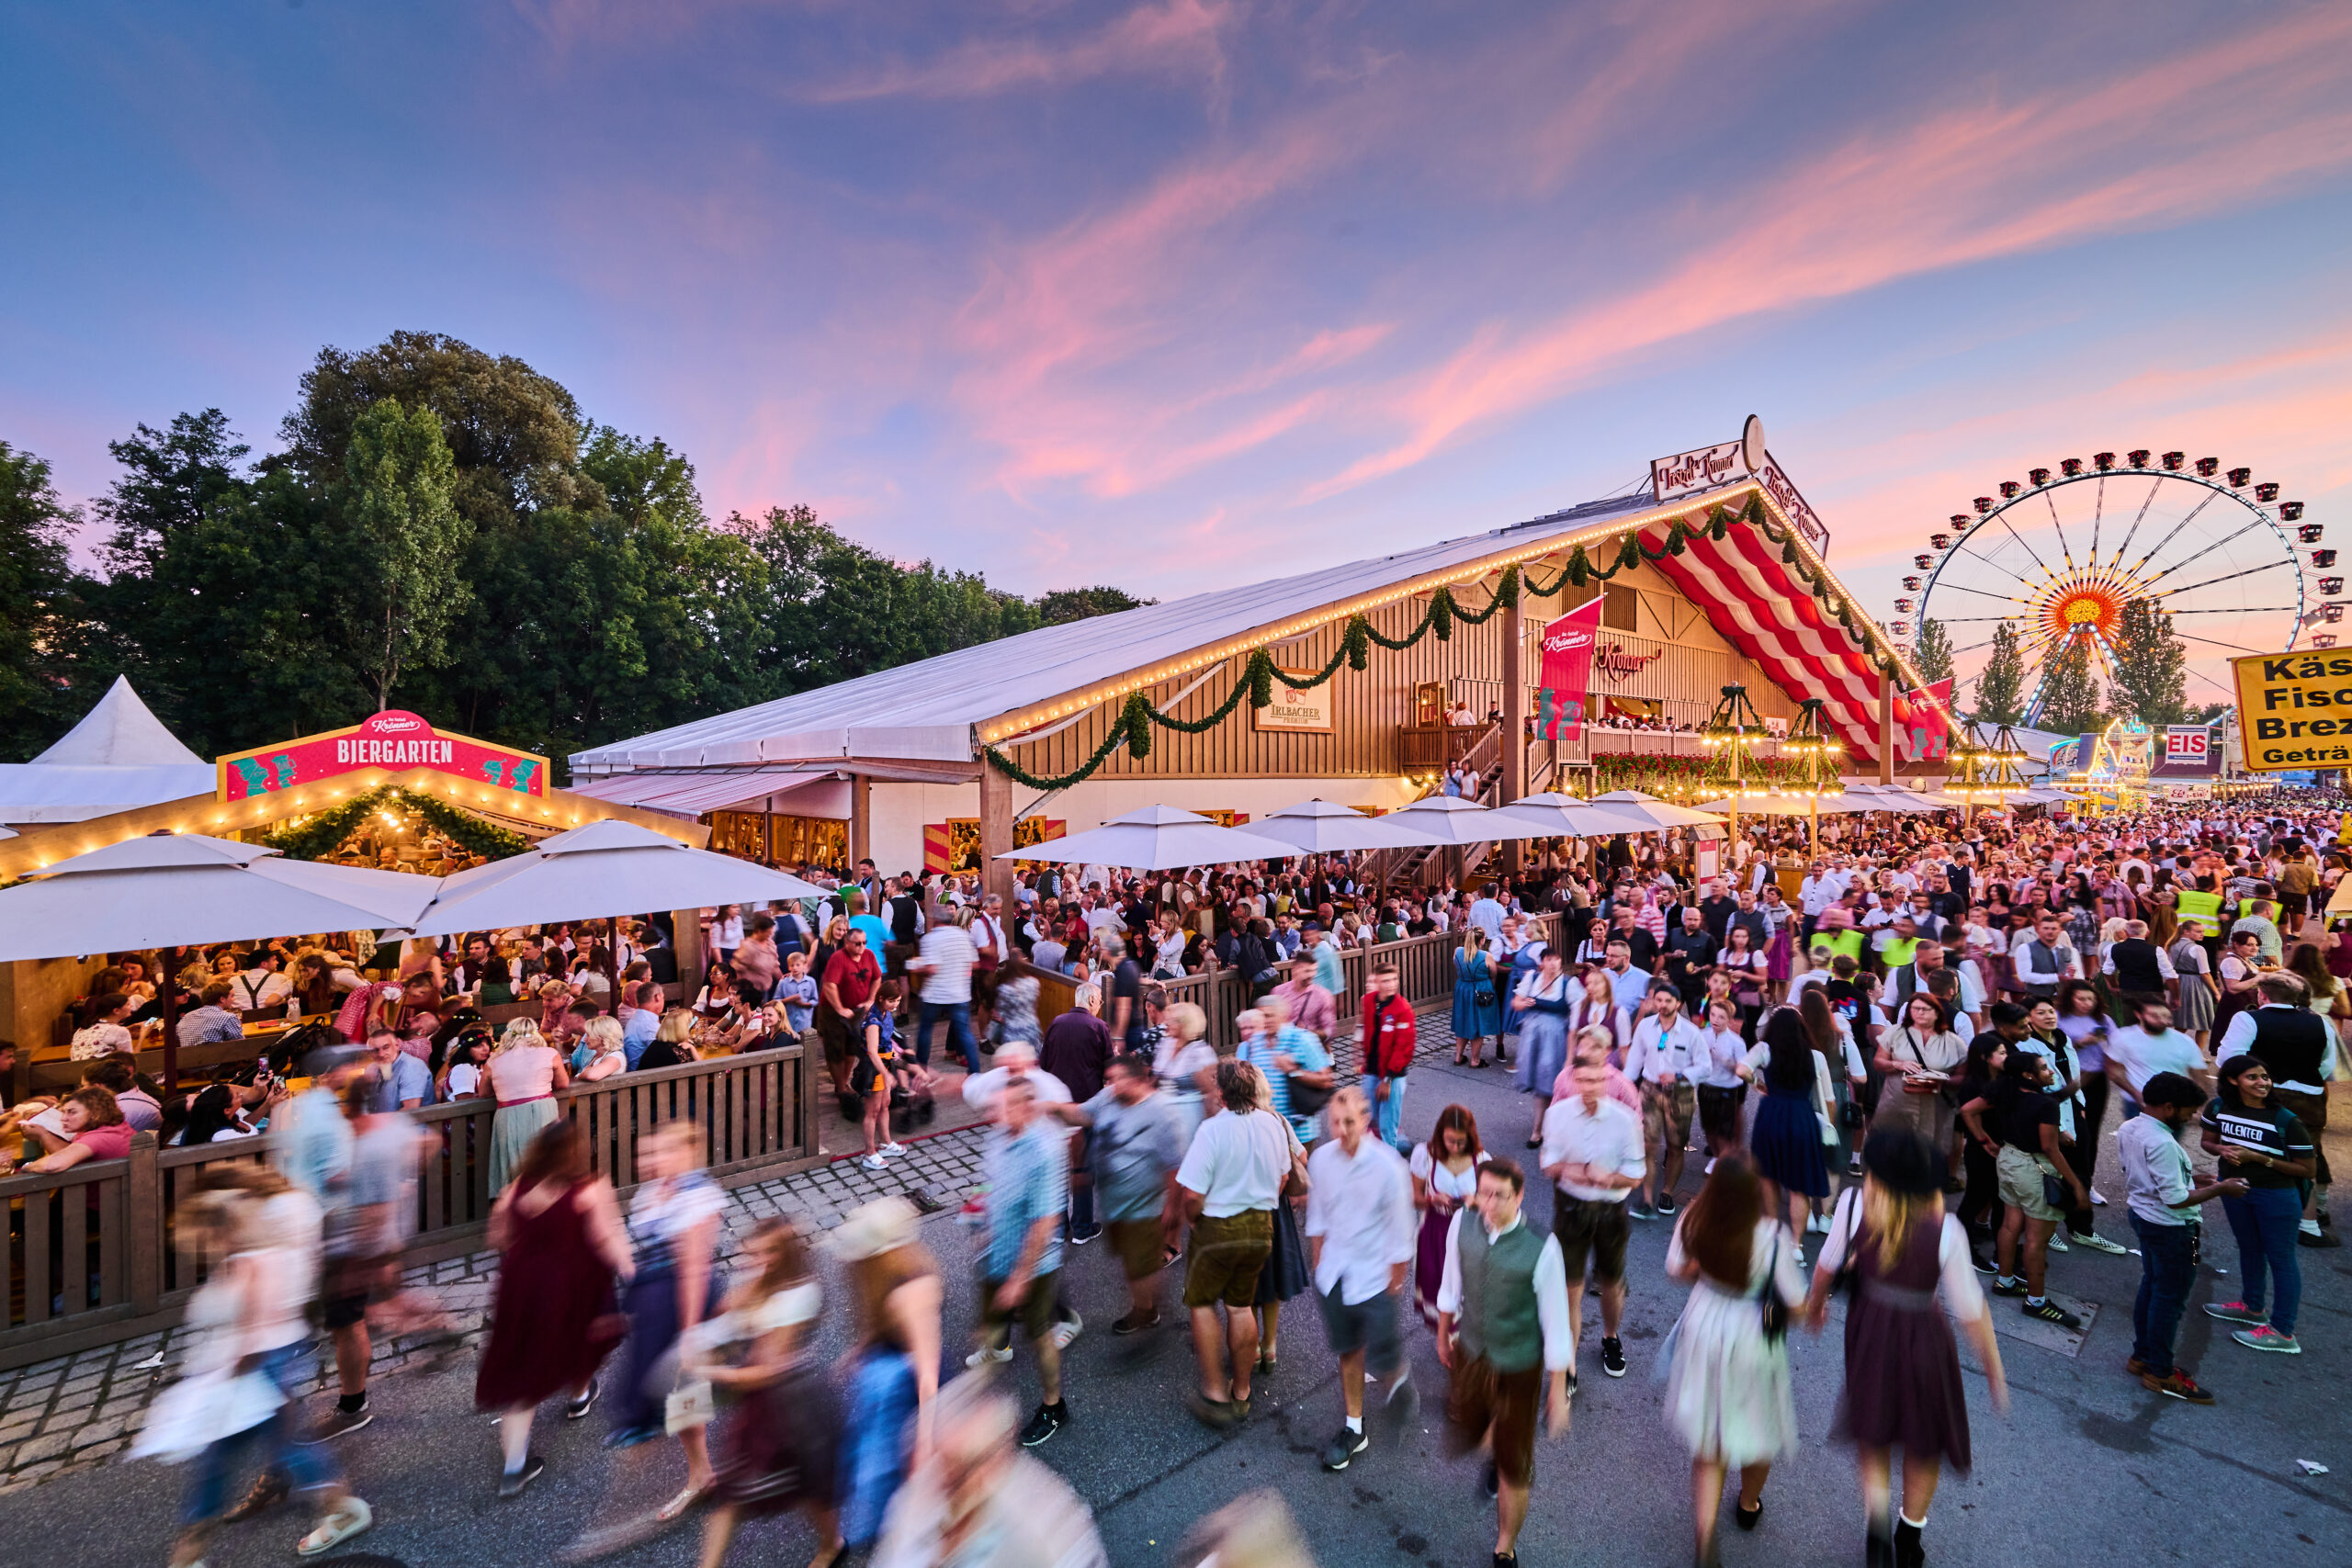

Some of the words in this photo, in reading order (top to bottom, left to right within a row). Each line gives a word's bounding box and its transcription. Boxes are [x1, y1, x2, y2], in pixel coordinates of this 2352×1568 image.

[2264, 656, 2352, 682] Käs
[1271, 704, 1320, 719] IRLBACHER
[337, 739, 452, 763] BIERGARTEN
[2168, 735, 2206, 753] EIS
[2221, 1121, 2263, 1142] TALENTED
